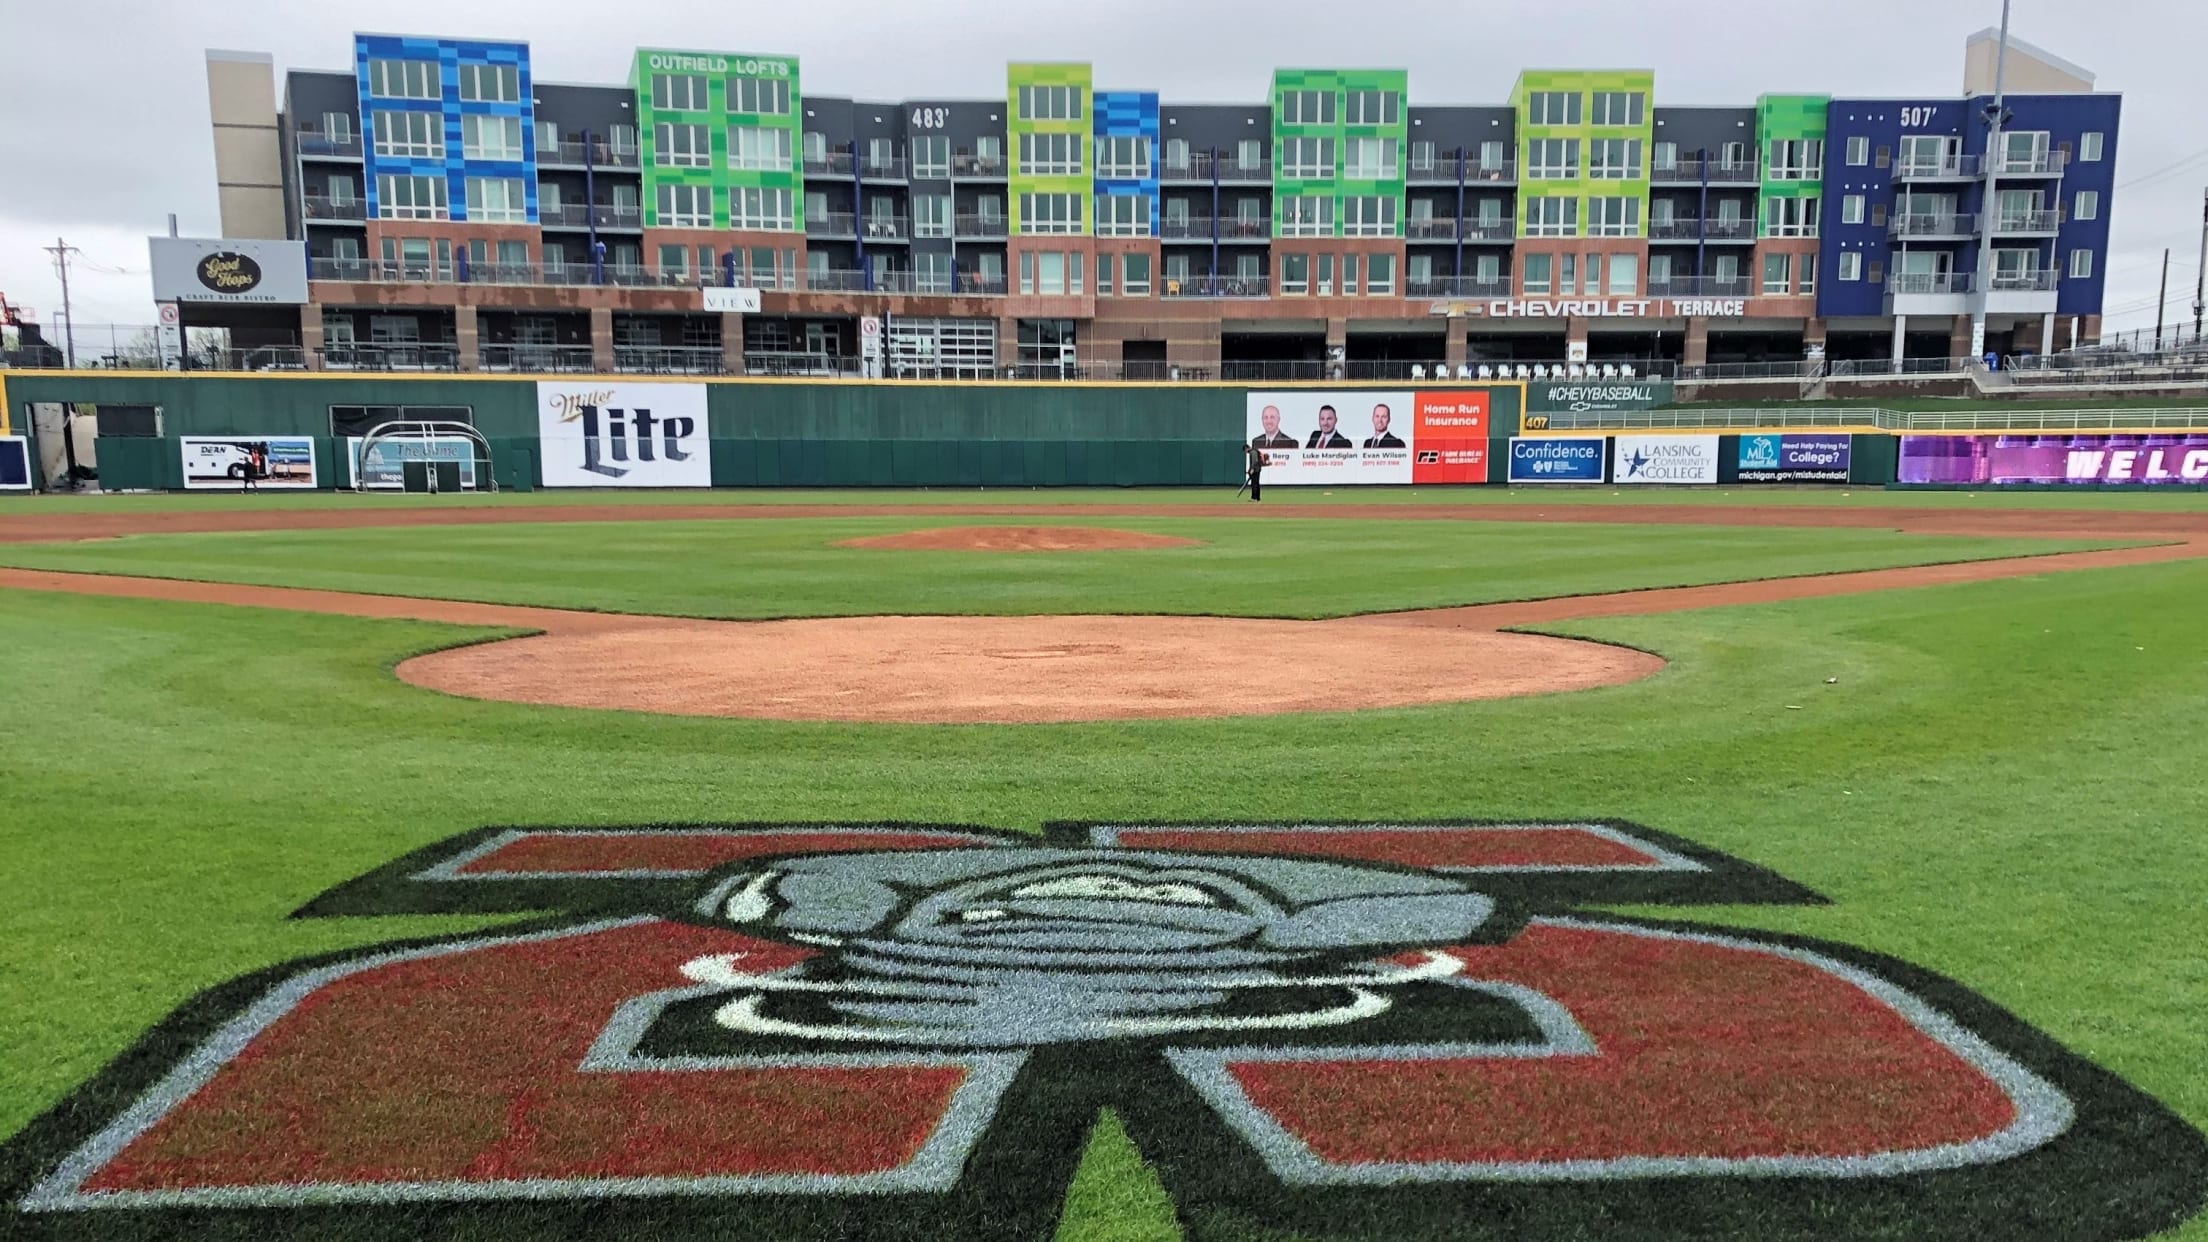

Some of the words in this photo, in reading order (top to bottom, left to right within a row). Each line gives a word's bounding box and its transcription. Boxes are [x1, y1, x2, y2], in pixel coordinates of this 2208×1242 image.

[650, 54, 728, 73] OUTFIELD
[736, 59, 789, 76] LOFTS
[911, 107, 950, 129] 483'
[1900, 106, 1938, 128] 507'
[205, 257, 240, 279] Good
[216, 272, 253, 288] Hops
[706, 297, 757, 309] VIEW
[1489, 300, 1651, 317] CHEVROLET
[1672, 300, 1744, 316] TERRACE
[1548, 386, 1653, 401] #CHEVYBASEBALL
[550, 389, 616, 418] Miller
[1423, 404, 1456, 414] Home
[1458, 404, 1481, 414] Run
[1425, 416, 1478, 427] Insurance
[1526, 416, 1549, 430] 407
[577, 405, 694, 478] Lite
[200, 446, 226, 454] DEAN
[398, 444, 421, 457] The
[1514, 443, 1599, 459] Confidence.
[1644, 444, 1701, 457] LANSING
[1653, 457, 1711, 466] COMMUNITY
[1789, 451, 1840, 464] College?
[1644, 467, 1705, 479] COLLEGE
[1738, 471, 1847, 481] michigan.gov/mistudentaid
